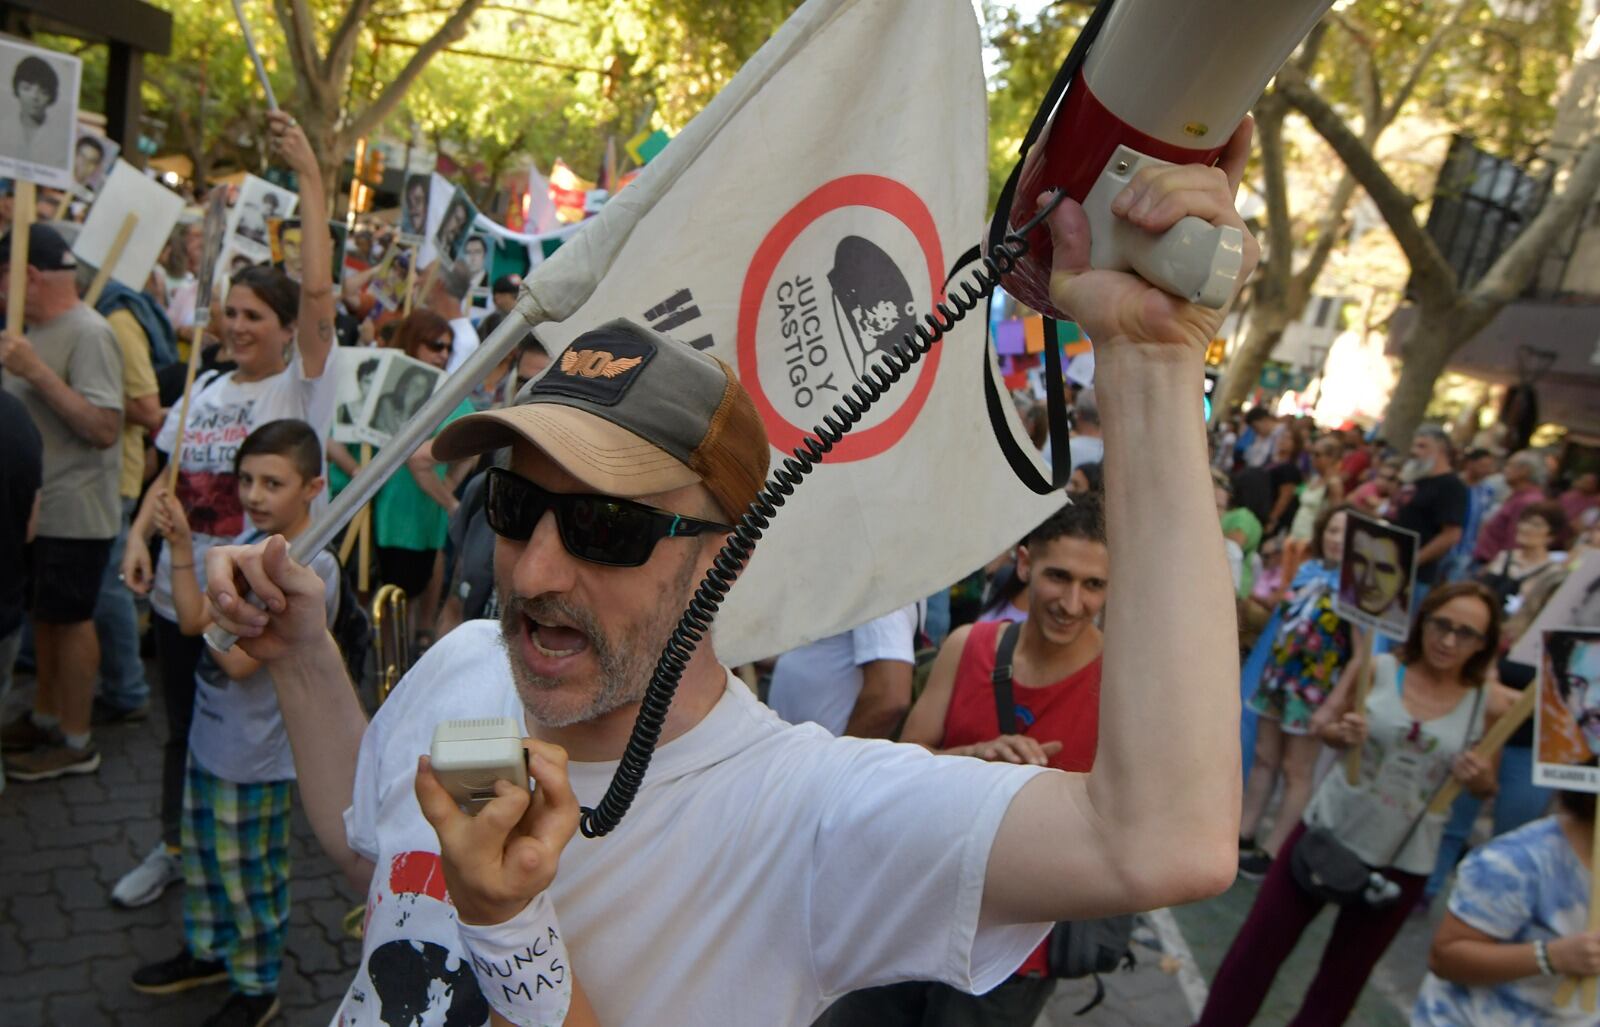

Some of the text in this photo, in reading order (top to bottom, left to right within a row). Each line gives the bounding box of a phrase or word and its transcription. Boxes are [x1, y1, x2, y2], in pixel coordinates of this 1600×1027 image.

[777, 281, 813, 408] CASTIGO
[796, 275, 838, 391] JUICIO Y
[471, 926, 559, 978] NUNCA
[502, 958, 565, 1004] MAS
